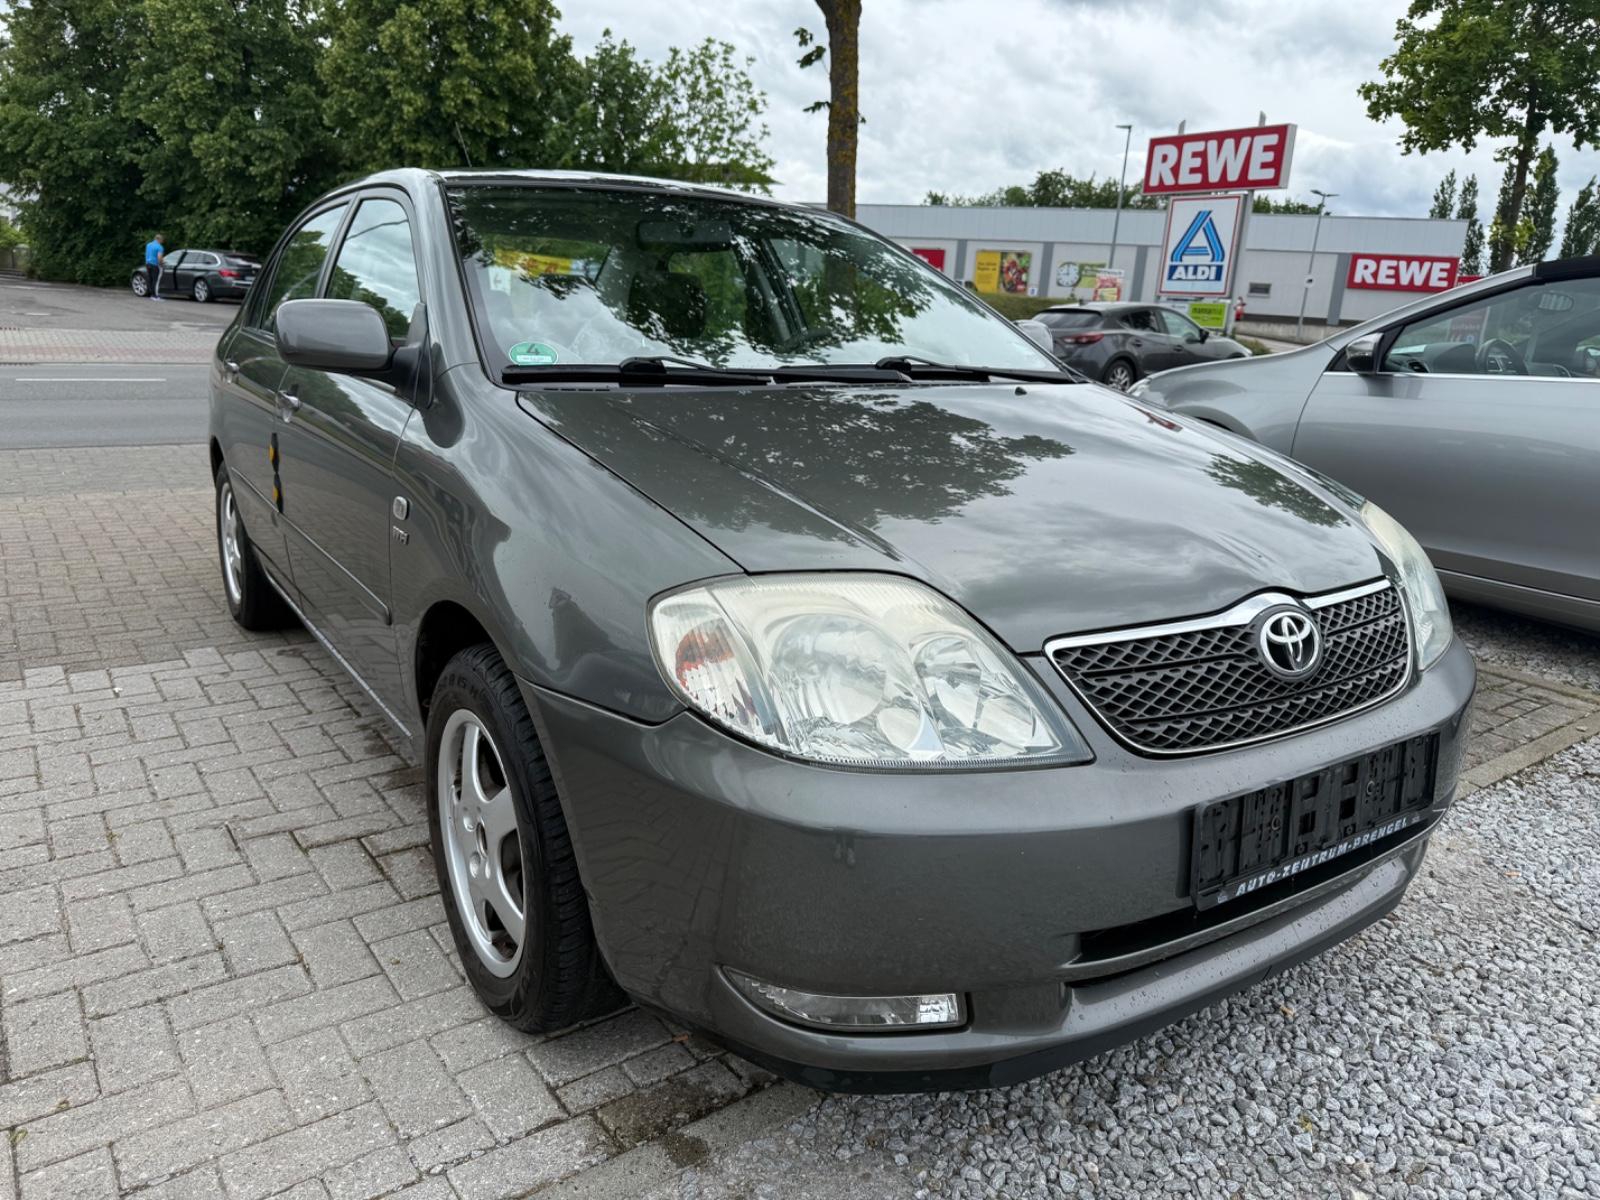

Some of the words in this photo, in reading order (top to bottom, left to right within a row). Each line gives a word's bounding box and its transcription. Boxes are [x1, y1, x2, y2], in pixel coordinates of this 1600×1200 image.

[1149, 133, 1279, 187] REWE
[1171, 265, 1217, 281] ALDI
[1353, 258, 1451, 288] REWE
[527, 343, 541, 356] 4
